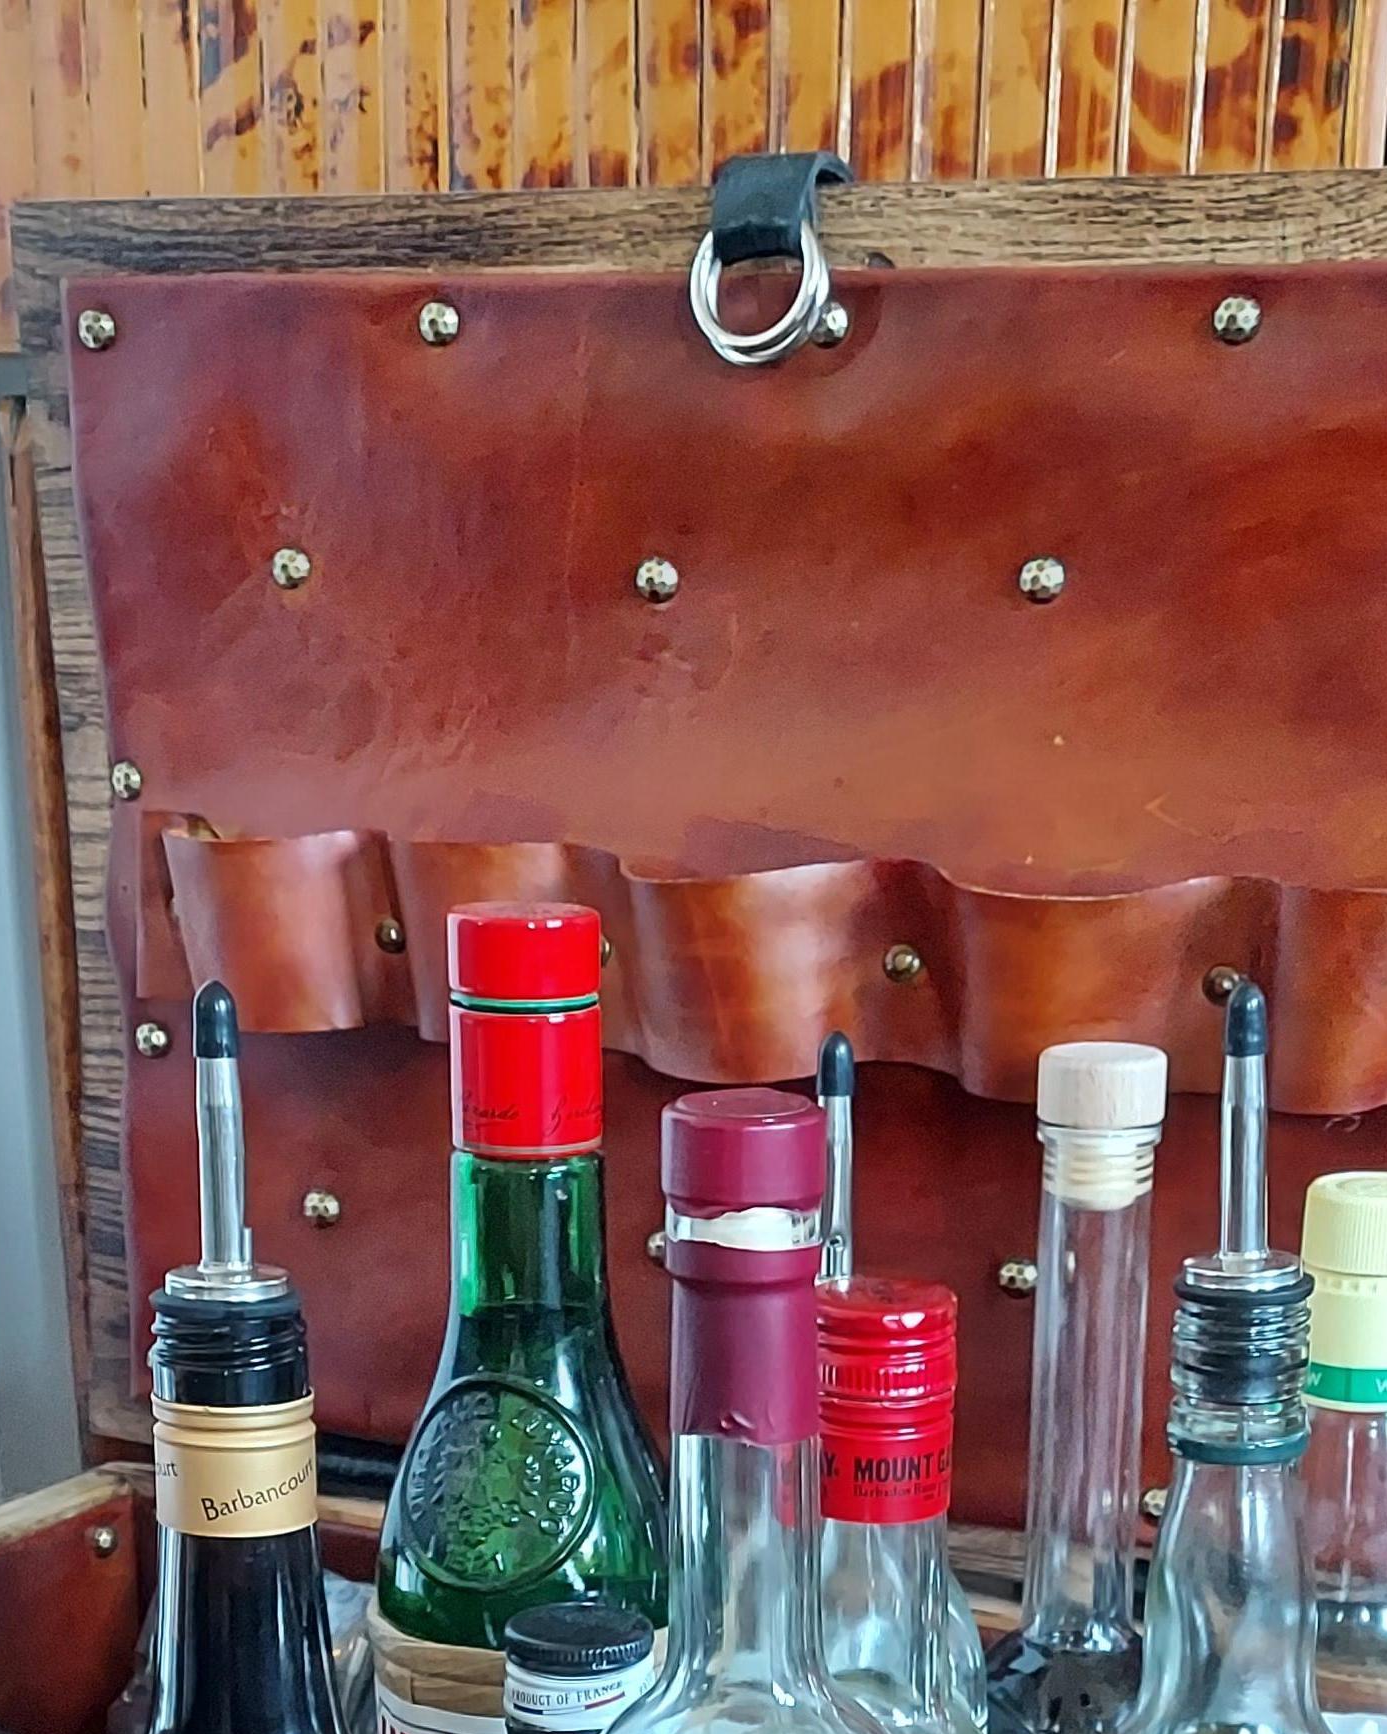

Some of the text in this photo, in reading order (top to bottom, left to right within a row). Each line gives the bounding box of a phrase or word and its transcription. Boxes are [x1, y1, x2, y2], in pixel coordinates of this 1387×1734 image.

[854, 1455, 935, 1483] MOUNT
[201, 1458, 313, 1521] Barbancourt
[512, 1687, 551, 1706] PRODUCT
[556, 1693, 571, 1706] OF
[576, 1679, 623, 1703] FRANCE
